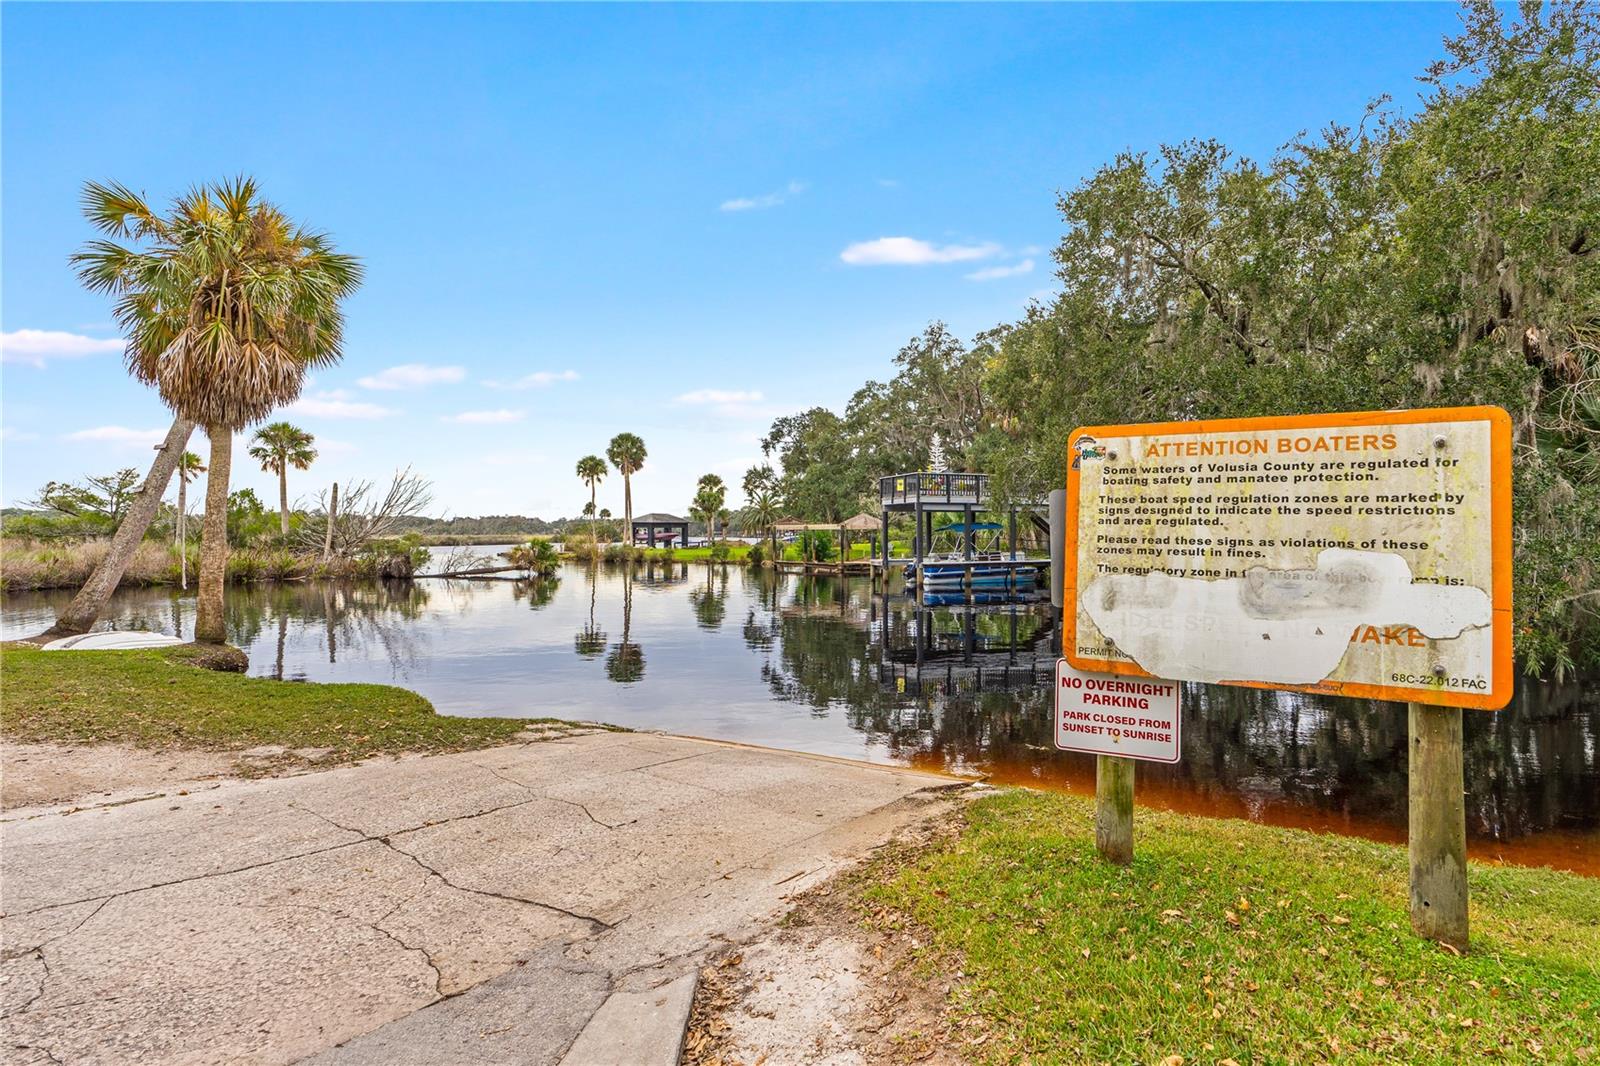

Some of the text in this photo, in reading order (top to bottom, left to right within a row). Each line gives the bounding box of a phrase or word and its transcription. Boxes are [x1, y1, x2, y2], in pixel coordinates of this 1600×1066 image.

[1146, 434, 1398, 458] ATTENTION BOATERS
[1103, 457, 1460, 475] Some waters of Volusia County are regulated for
[1103, 472, 1379, 486] boating safety and manatee protection.
[1099, 492, 1465, 506] These boat speed regulation zones are marked by
[1098, 505, 1456, 517] signs designed to indicate the speed restrictions
[1097, 516, 1224, 527] and area regulated.
[1097, 535, 1429, 550] Please read these signs as violations of these
[1097, 547, 1266, 558] zones may result in fines.
[1097, 564, 1119, 573] The
[1190, 568, 1221, 577] zone
[1225, 568, 1237, 578] in
[1062, 677, 1173, 697] NO OVERNIGHT
[1392, 673, 1487, 690] 68C-22.012 FAC
[1083, 693, 1149, 710] PARKING
[1063, 710, 1171, 730] PARK CLOSED FROM
[1063, 722, 1172, 743] SUNSET TO SUNRISE
